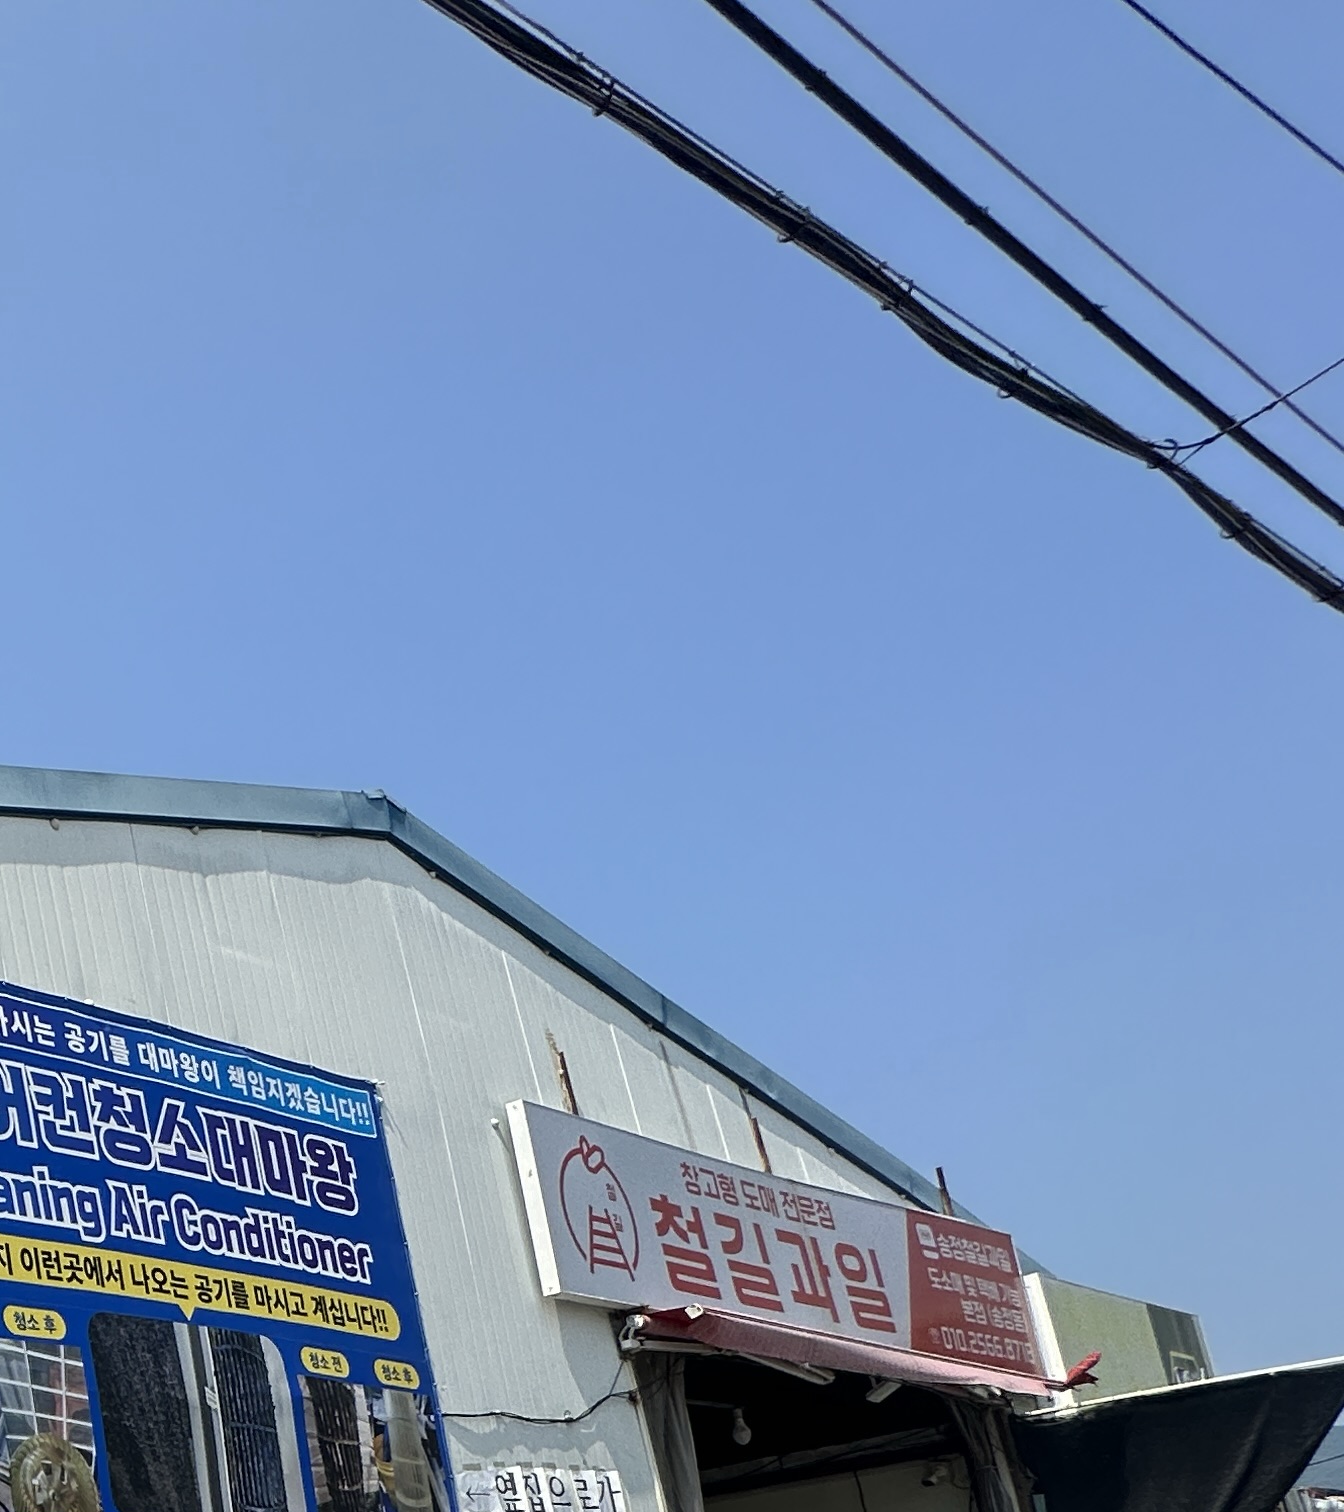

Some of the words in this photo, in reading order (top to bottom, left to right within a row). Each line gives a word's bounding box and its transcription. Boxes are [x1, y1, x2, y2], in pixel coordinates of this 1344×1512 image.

[64, 1023, 130, 1065] 공기를
[138, 1044, 220, 1091] 대마왕이
[228, 1064, 372, 1126] 책임지겠습니다!!
[111, 1180, 169, 1244] Air
[172, 1196, 372, 1284] Conditioner
[680, 1161, 738, 1206] 창고형
[740, 1179, 779, 1219] 도매
[779, 1190, 835, 1230] 전문점
[20, 1241, 125, 1291] 이런곳에서
[131, 1264, 189, 1301] 나오는
[194, 1274, 249, 1311] 공기를
[254, 1285, 308, 1321] 마시고
[311, 1292, 390, 1334] 계십니다!!
[649, 1193, 897, 1333] 철길과일
[13, 1310, 40, 1332] 청소
[42, 1312, 57, 1336] 후
